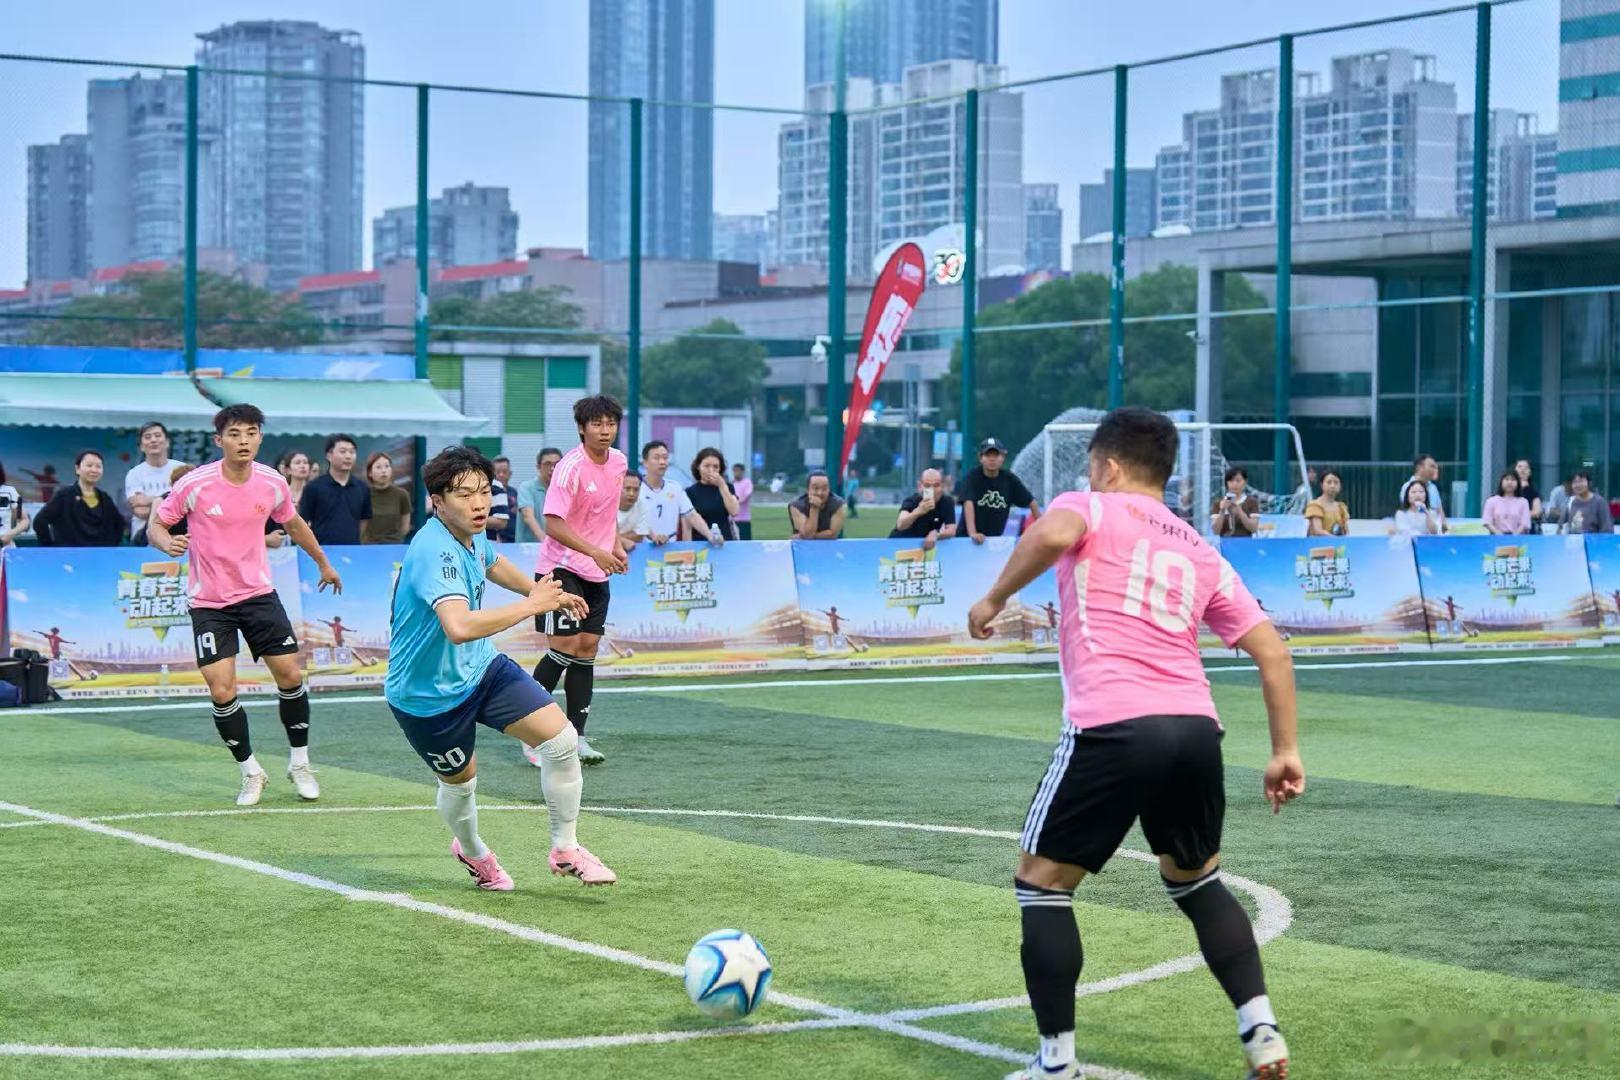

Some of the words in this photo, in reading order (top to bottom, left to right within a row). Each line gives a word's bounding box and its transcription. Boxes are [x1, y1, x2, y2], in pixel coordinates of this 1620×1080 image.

[656, 504, 663, 518] 7
[655, 581, 710, 602] 动起来
[888, 579, 936, 599] 动起来
[1123, 538, 1197, 633] 10
[196, 631, 218, 659] 19
[426, 746, 466, 772] 20
